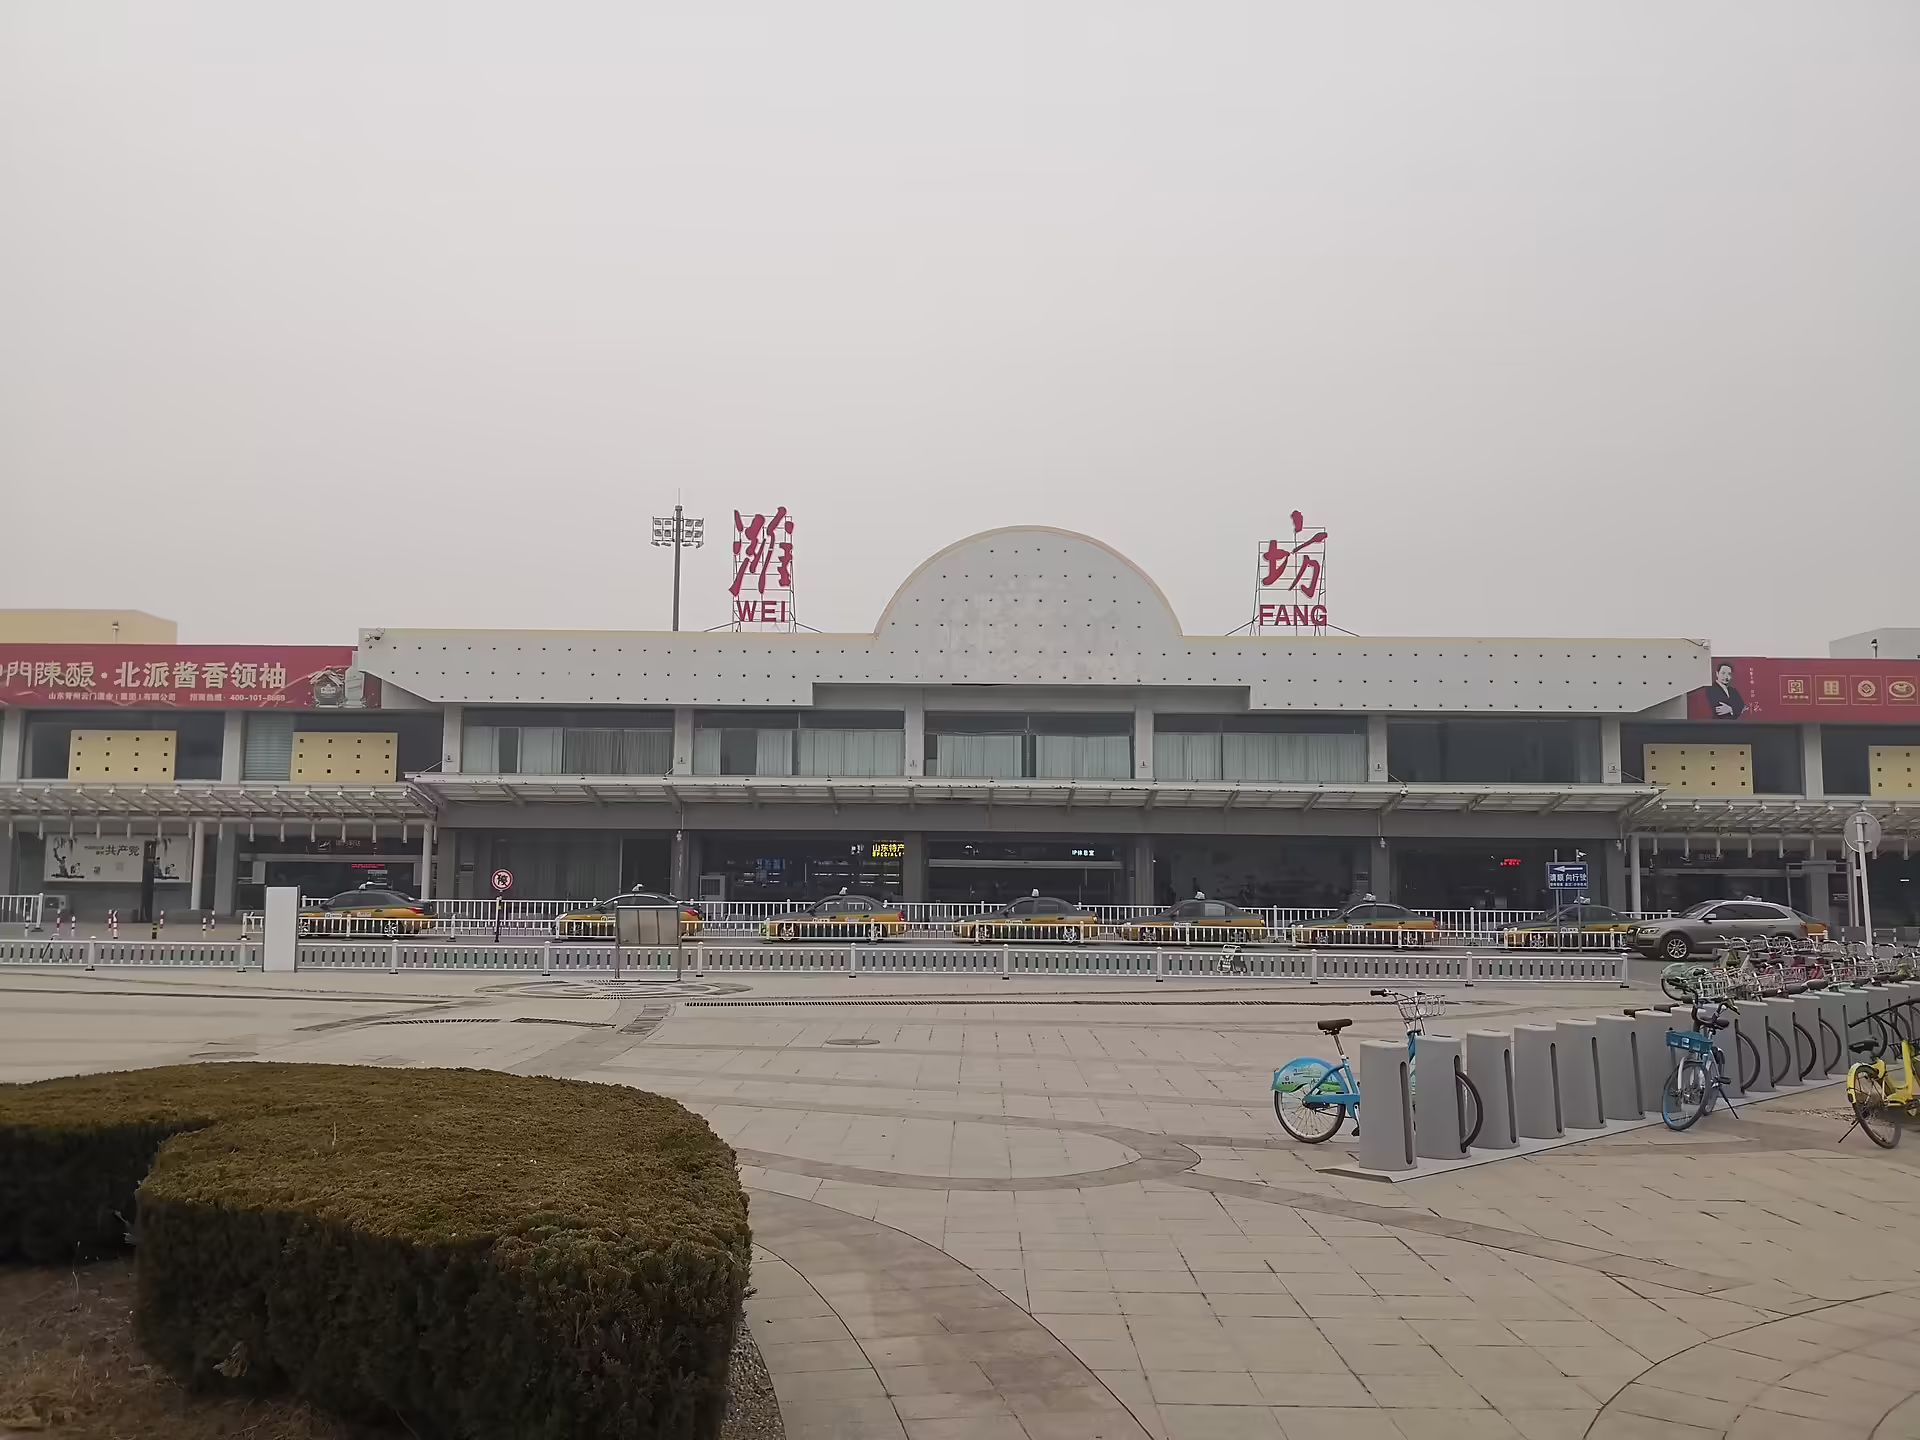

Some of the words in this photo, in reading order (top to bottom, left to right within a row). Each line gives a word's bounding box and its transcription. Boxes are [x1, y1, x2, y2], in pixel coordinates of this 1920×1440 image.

[1261, 510, 1328, 599] 坊
[735, 600, 786, 622] WEI
[1259, 604, 1328, 626] FANG
[105, 844, 140, 857] 共产党
[872, 843, 905, 853] 山东特产
